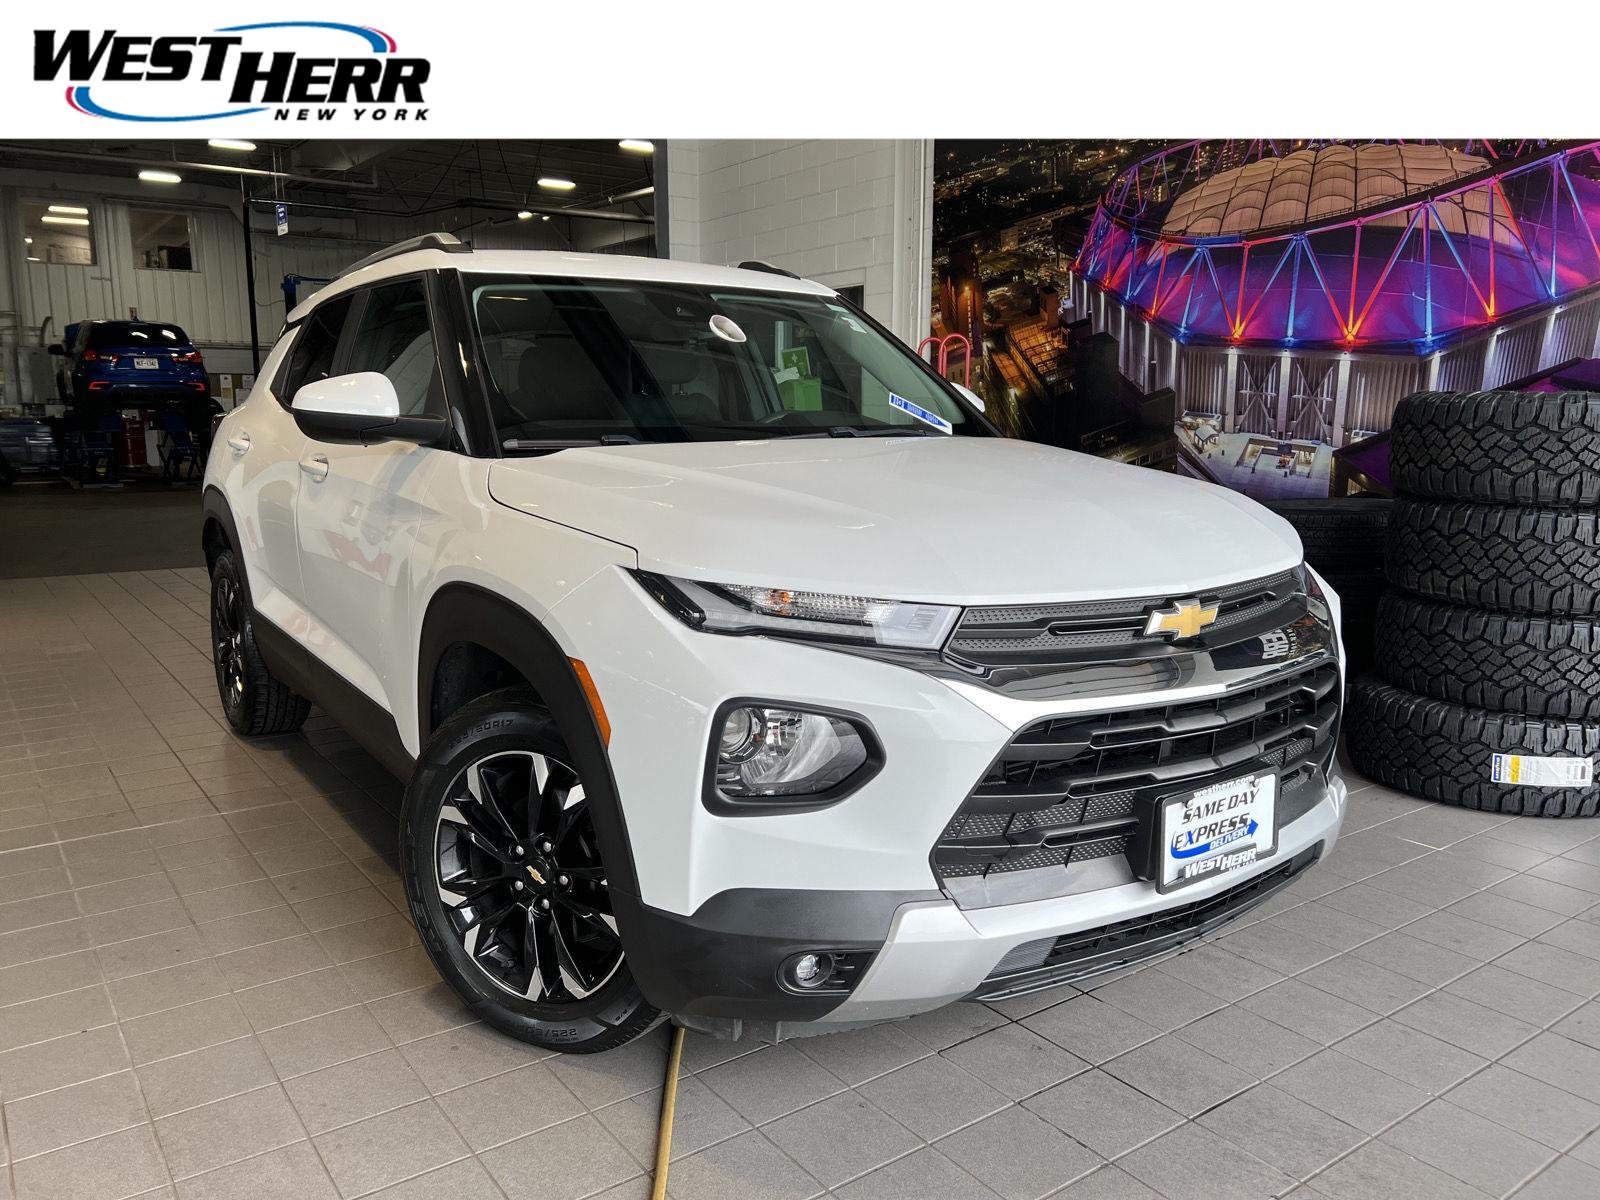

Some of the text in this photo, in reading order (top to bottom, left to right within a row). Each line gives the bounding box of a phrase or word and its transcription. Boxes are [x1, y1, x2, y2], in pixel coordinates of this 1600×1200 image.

[1183, 788, 1259, 824] SAME DAY
[1175, 813, 1249, 849] EXPRESS
[1211, 826, 1250, 850] DELIVERY
[1184, 854, 1225, 878] WEST
[1219, 848, 1257, 871] HERR
